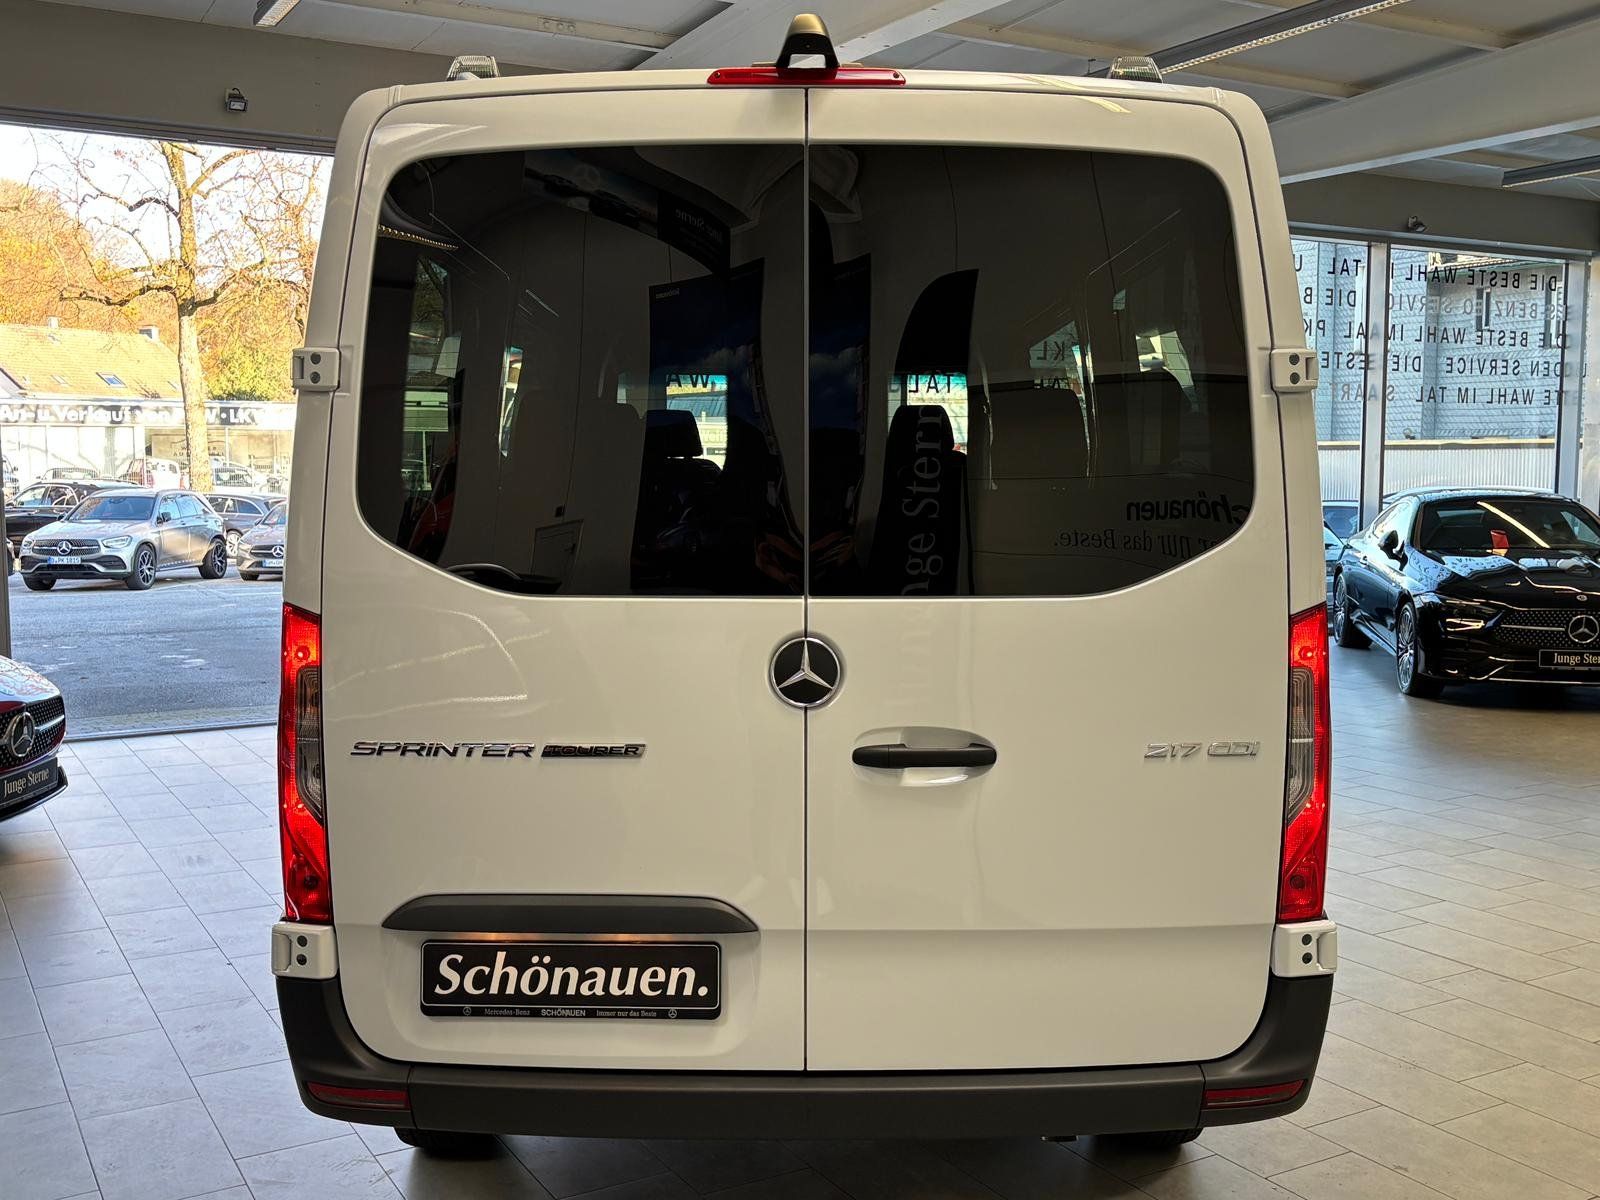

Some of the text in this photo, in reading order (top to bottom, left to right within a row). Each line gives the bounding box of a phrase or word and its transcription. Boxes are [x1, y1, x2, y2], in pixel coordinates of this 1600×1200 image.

[1553, 652, 1581, 666] Junge
[350, 741, 643, 758] SPRINTER TOURER
[1144, 742, 1202, 758] 217
[4, 768, 50, 798] Junge Sterne
[434, 951, 709, 997] Schönauen.
[484, 1008, 531, 1016] Mercedes-Benz
[541, 1008, 586, 1017] SCHÖNAUEN
